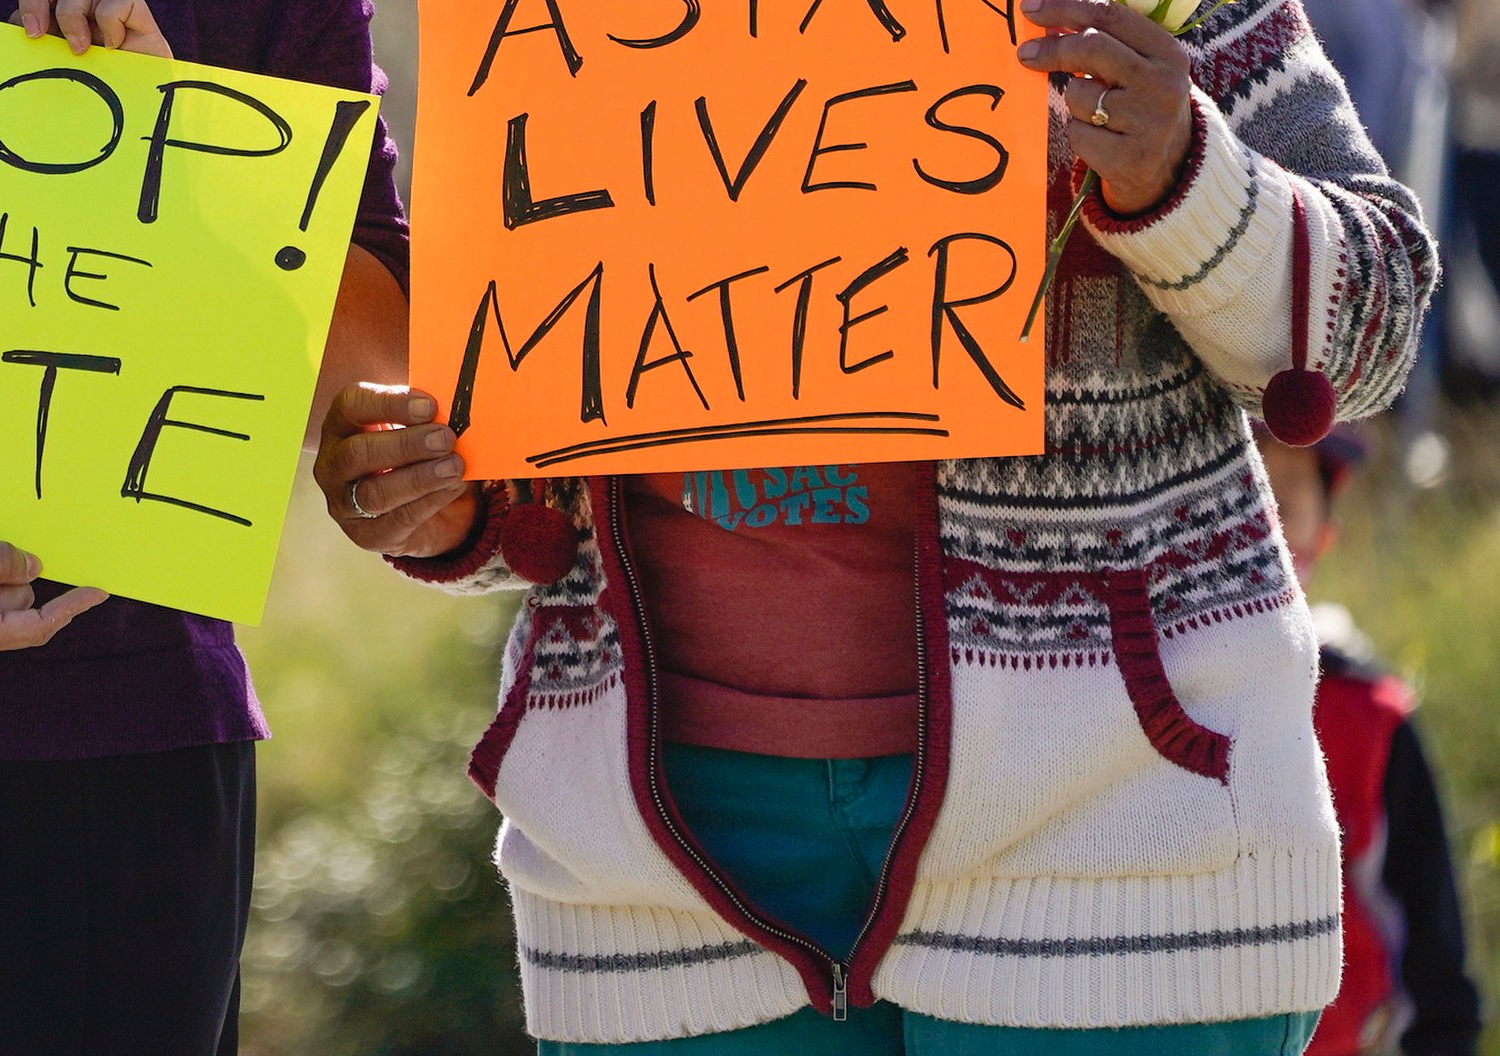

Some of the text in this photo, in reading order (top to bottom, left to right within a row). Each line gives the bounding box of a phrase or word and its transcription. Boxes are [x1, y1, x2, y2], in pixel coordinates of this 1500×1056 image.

[502, 78, 1009, 231] LIVES
[447, 232, 1026, 440] MATTER
[715, 486, 870, 531] VOTES
